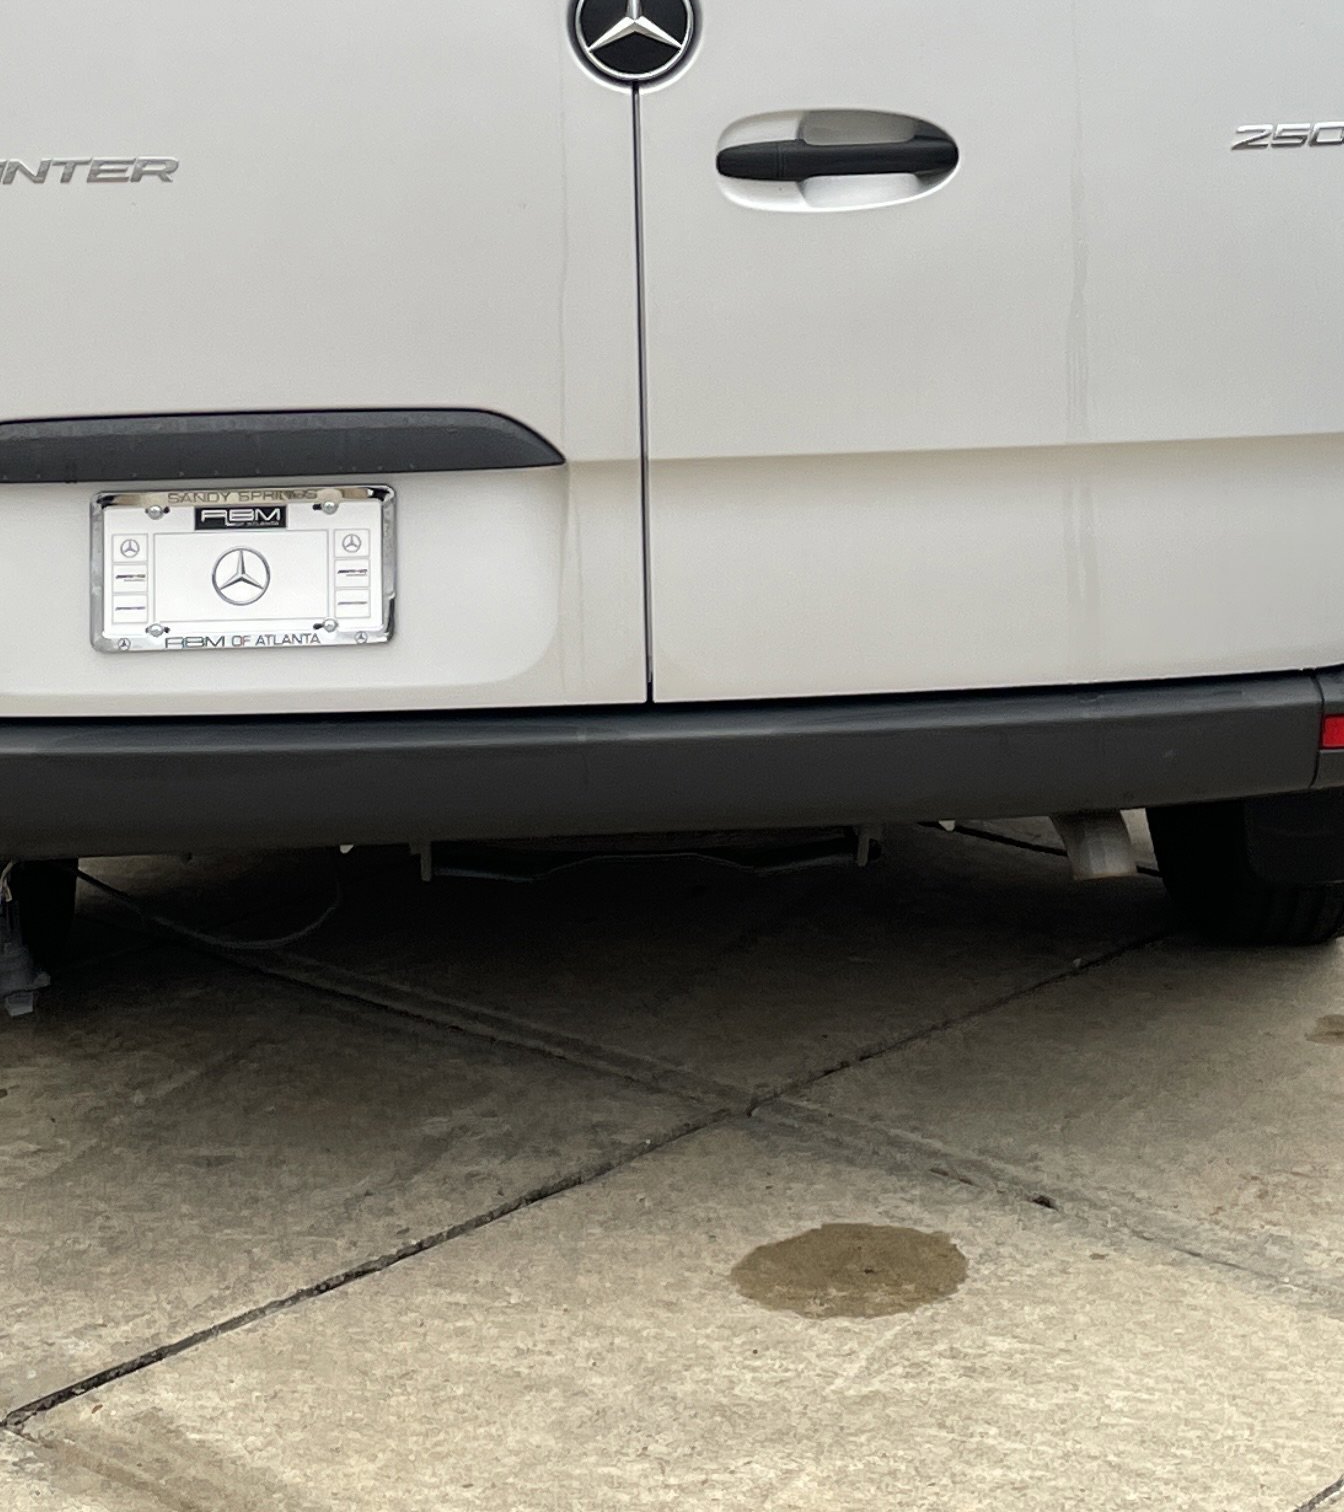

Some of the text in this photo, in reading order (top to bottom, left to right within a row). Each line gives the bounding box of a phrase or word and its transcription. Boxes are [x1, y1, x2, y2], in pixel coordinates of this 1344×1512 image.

[167, 491, 233, 504] SANDY
[201, 508, 281, 526] RBM
[165, 633, 321, 648] RBM OF ATLANTA
